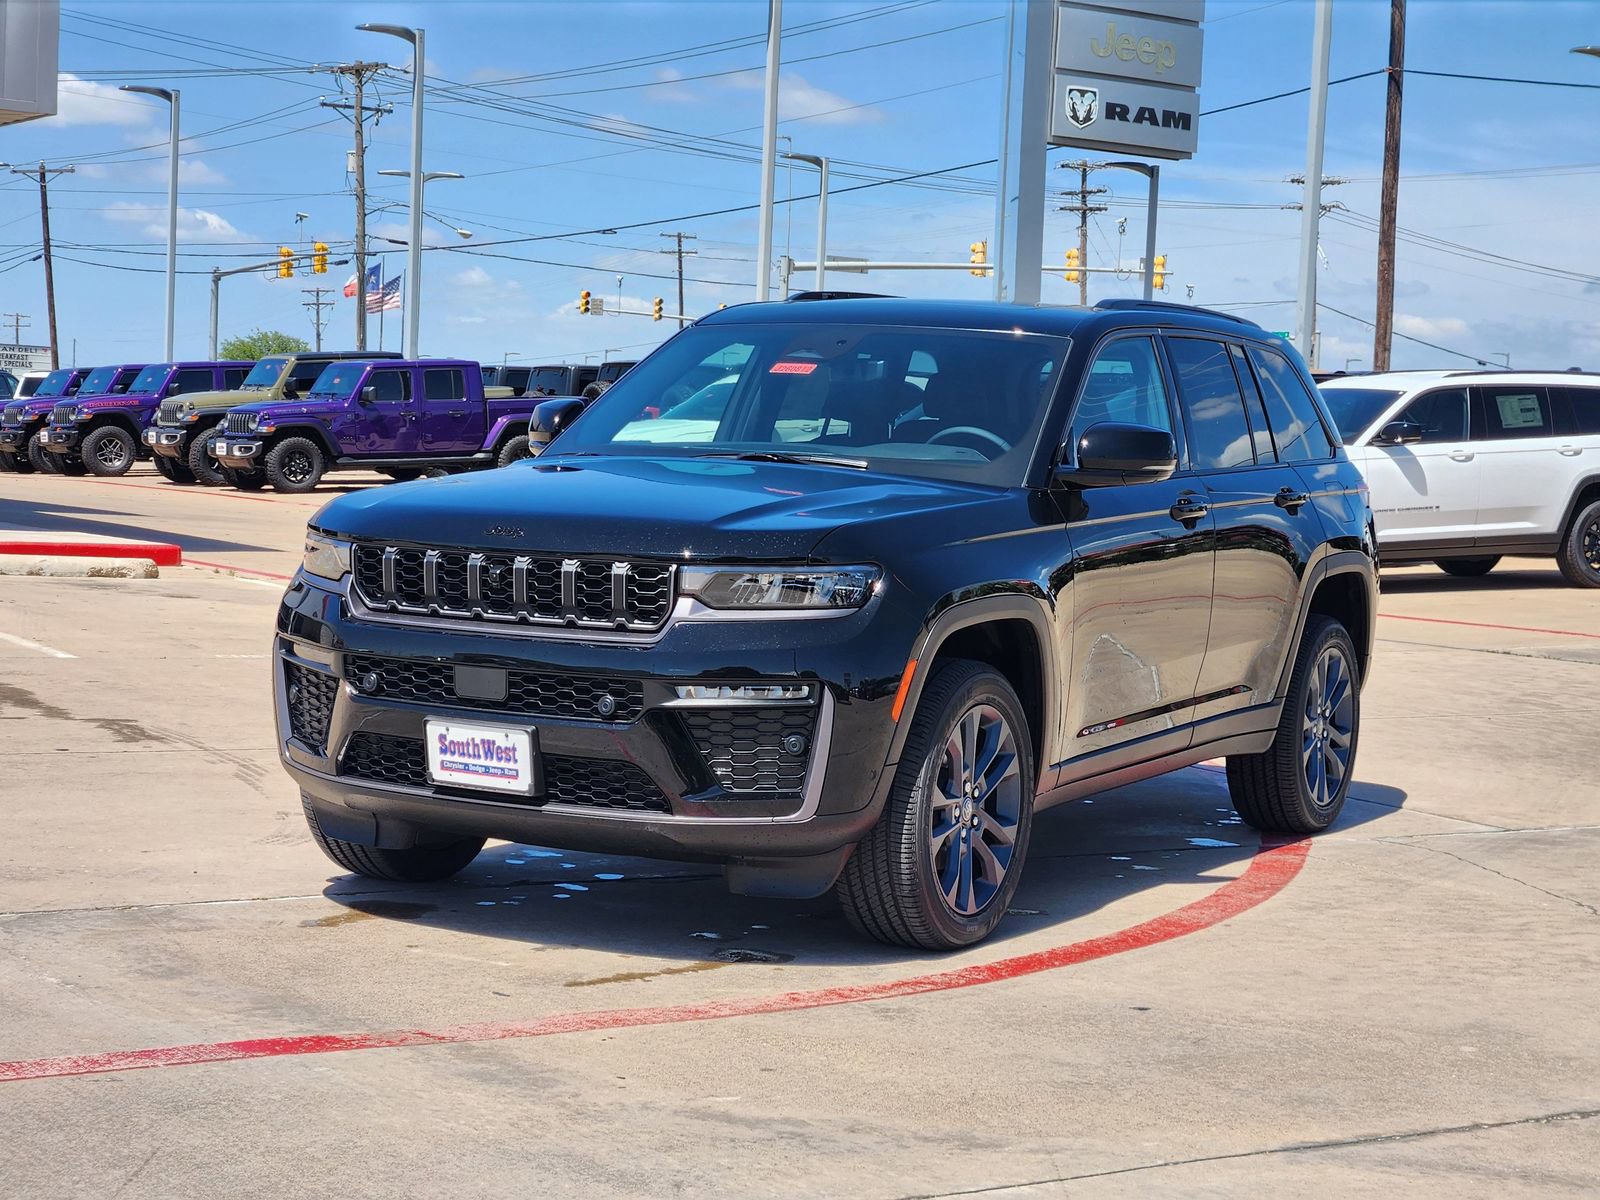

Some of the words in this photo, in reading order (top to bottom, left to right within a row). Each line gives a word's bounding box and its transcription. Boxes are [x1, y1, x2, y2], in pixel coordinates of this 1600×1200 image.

[1090, 21, 1177, 74] Jeep
[1105, 102, 1191, 131] RAM
[438, 733, 519, 764] SouthWest
[443, 760, 465, 769] Chrysler
[468, 763, 486, 773] Dodge
[489, 766, 502, 775] Jeep
[504, 768, 517, 776] Ram
